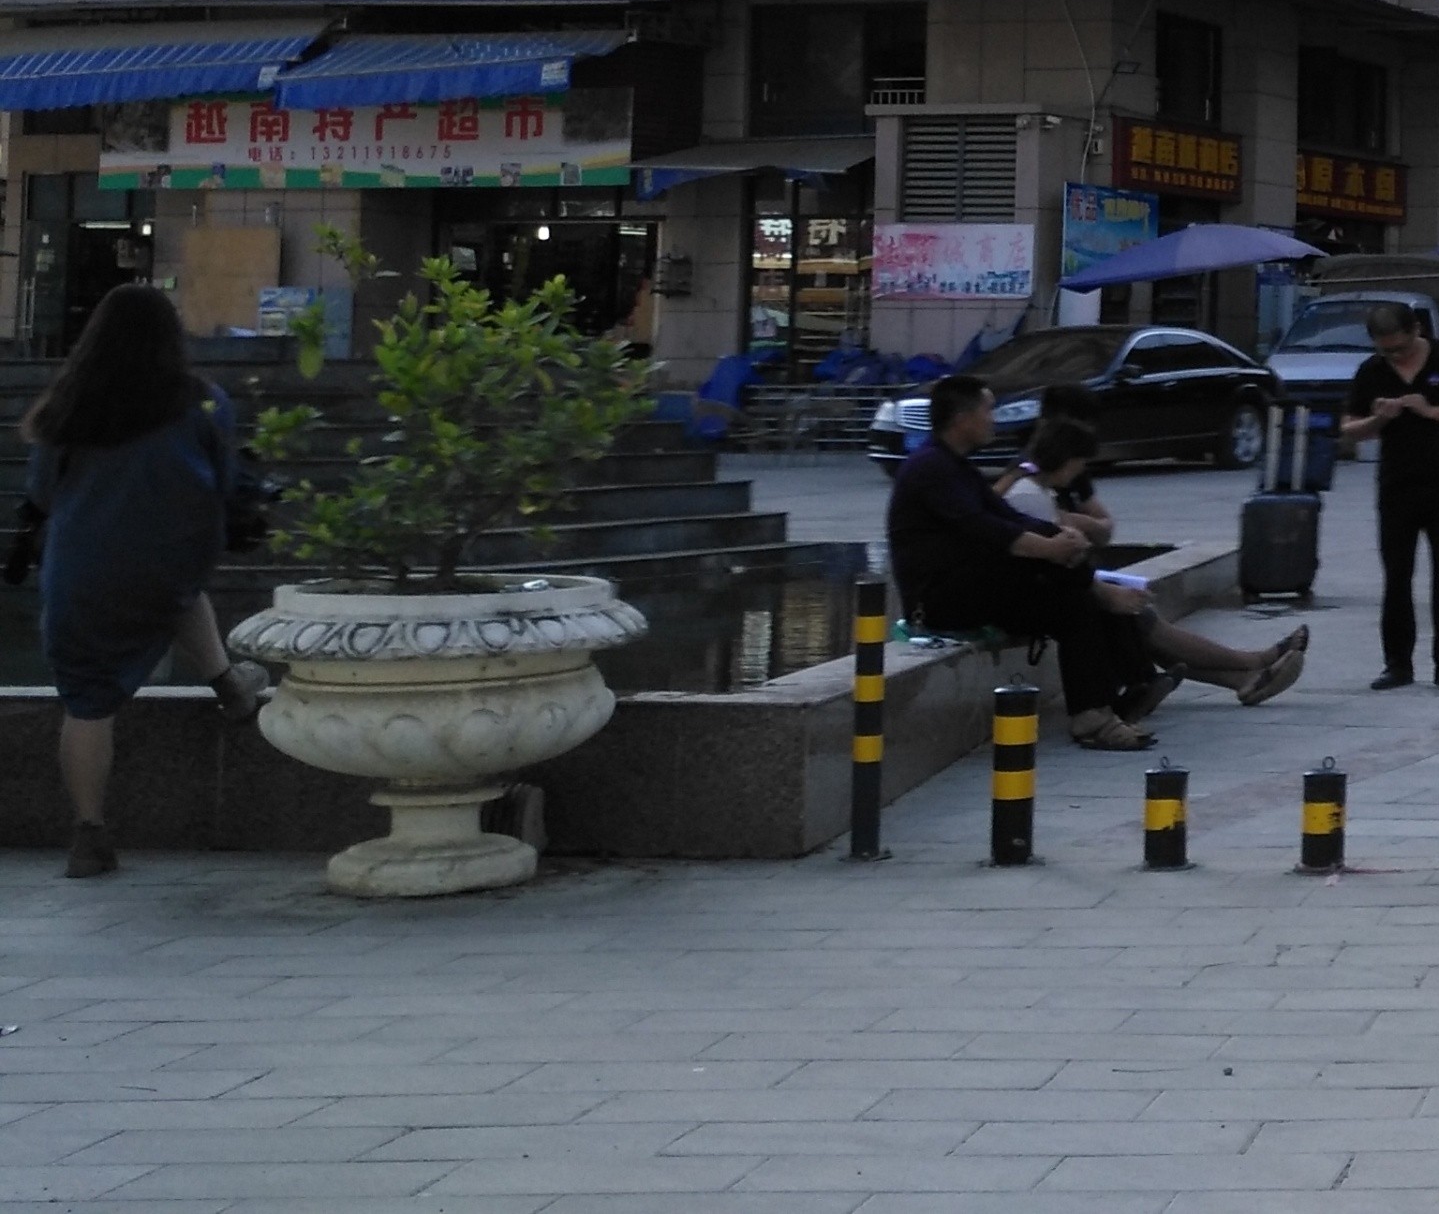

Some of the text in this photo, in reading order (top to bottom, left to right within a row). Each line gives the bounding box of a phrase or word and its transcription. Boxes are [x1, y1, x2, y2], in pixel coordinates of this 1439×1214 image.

[185, 98, 545, 144] 越南特产超市
